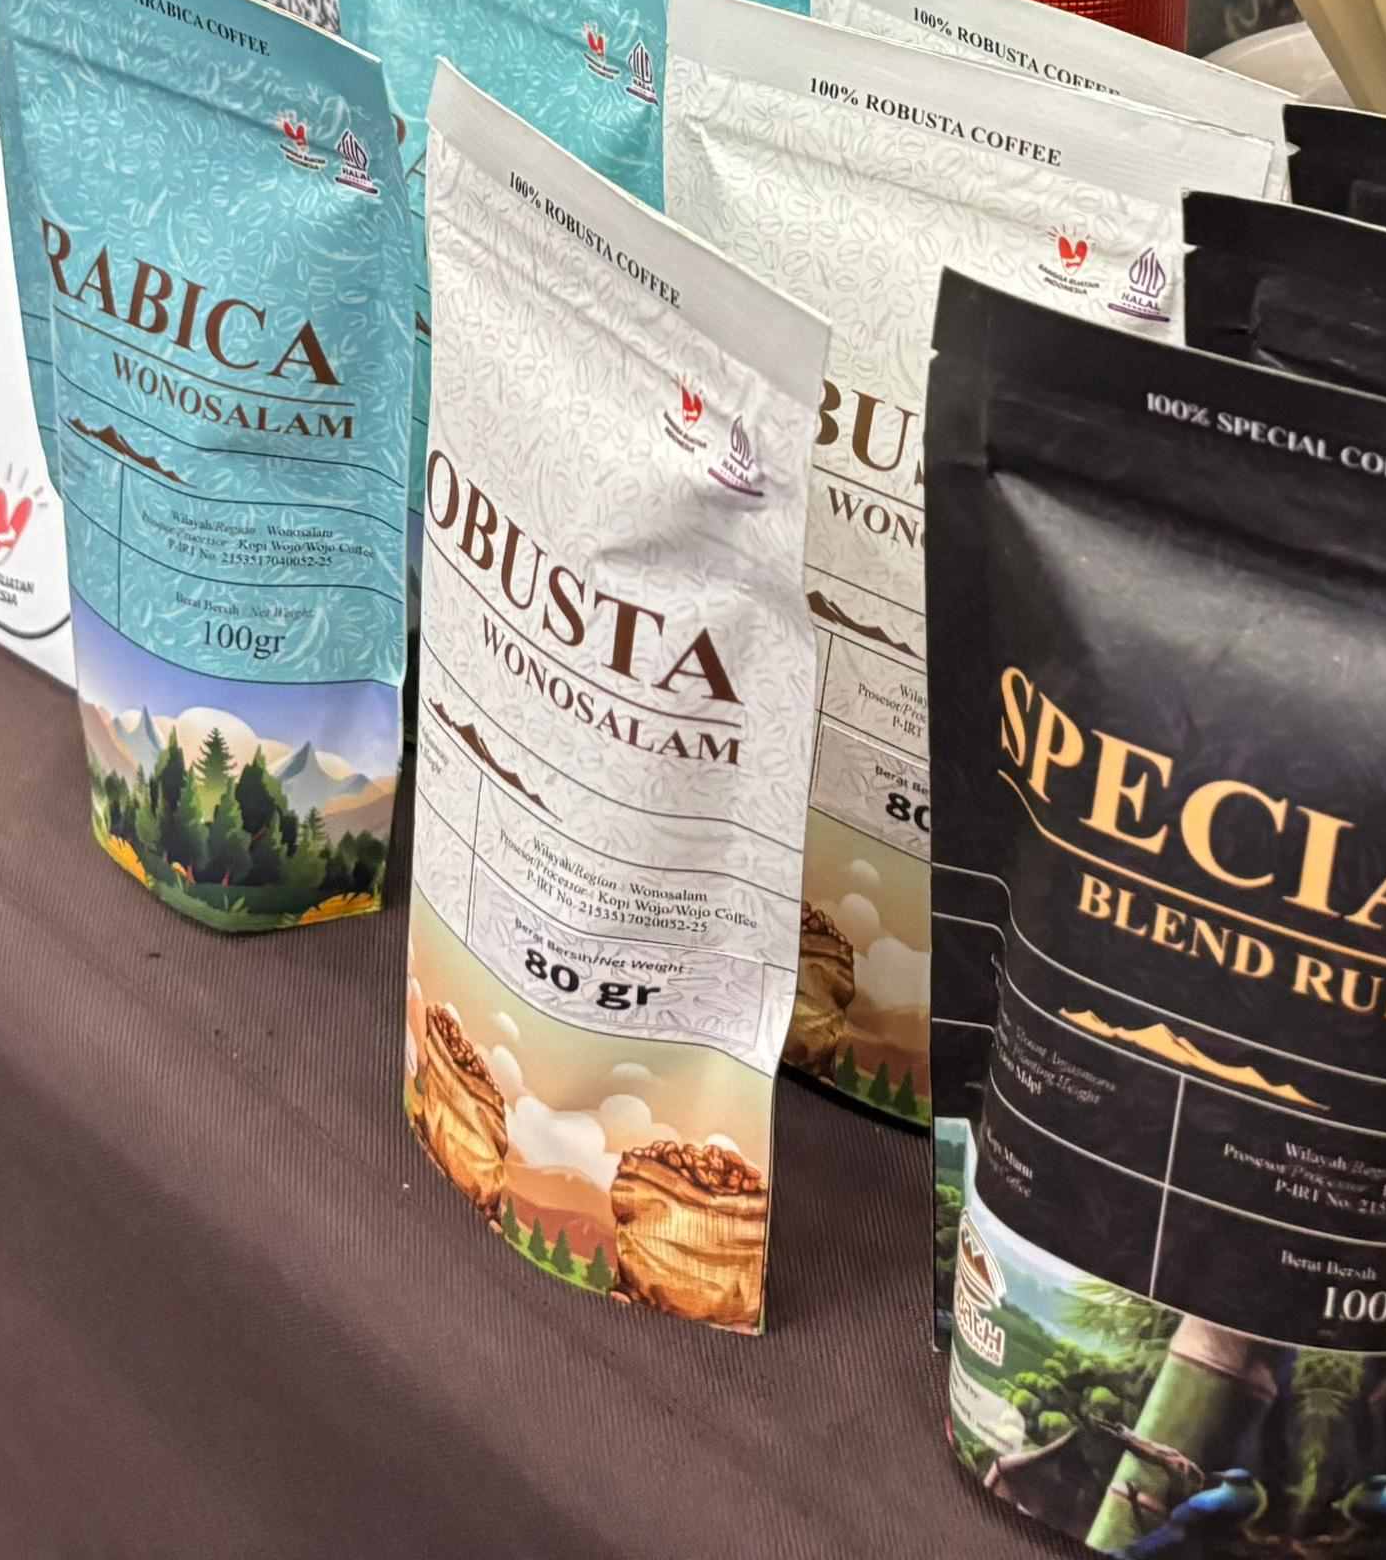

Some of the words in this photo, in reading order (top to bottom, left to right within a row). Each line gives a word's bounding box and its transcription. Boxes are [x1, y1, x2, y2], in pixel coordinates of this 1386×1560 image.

[205, 17, 272, 58] COFFEE
[911, 6, 953, 37] 100%
[956, 26, 1040, 74] ROBUSTA
[807, 76, 860, 108] 100%
[865, 93, 966, 139] ROBUSTA
[970, 125, 1063, 168] COFFEE
[509, 171, 543, 210] 100%
[543, 200, 614, 264] ROBUSTA
[616, 251, 683, 311] COFFEE
[40, 215, 344, 389] RABICA
[1121, 292, 1162, 311] HALAL
[112, 351, 355, 441] WONOSALAM
[1146, 391, 1212, 429] 100%
[1215, 410, 1334, 460] SPECIAL
[425, 448, 745, 708] OBUSTA
[203, 620, 286, 661] 100gr
[481, 613, 743, 767] WONOSALAM
[597, 890, 632, 911] Kopi
[633, 900, 712, 922] Wojo/Wojo
[713, 906, 759, 930] Coffee
[629, 882, 709, 903] Wonosalam
[1077, 872, 1276, 980] BLEND
[524, 947, 581, 993] 80
[595, 981, 663, 1012] gr
